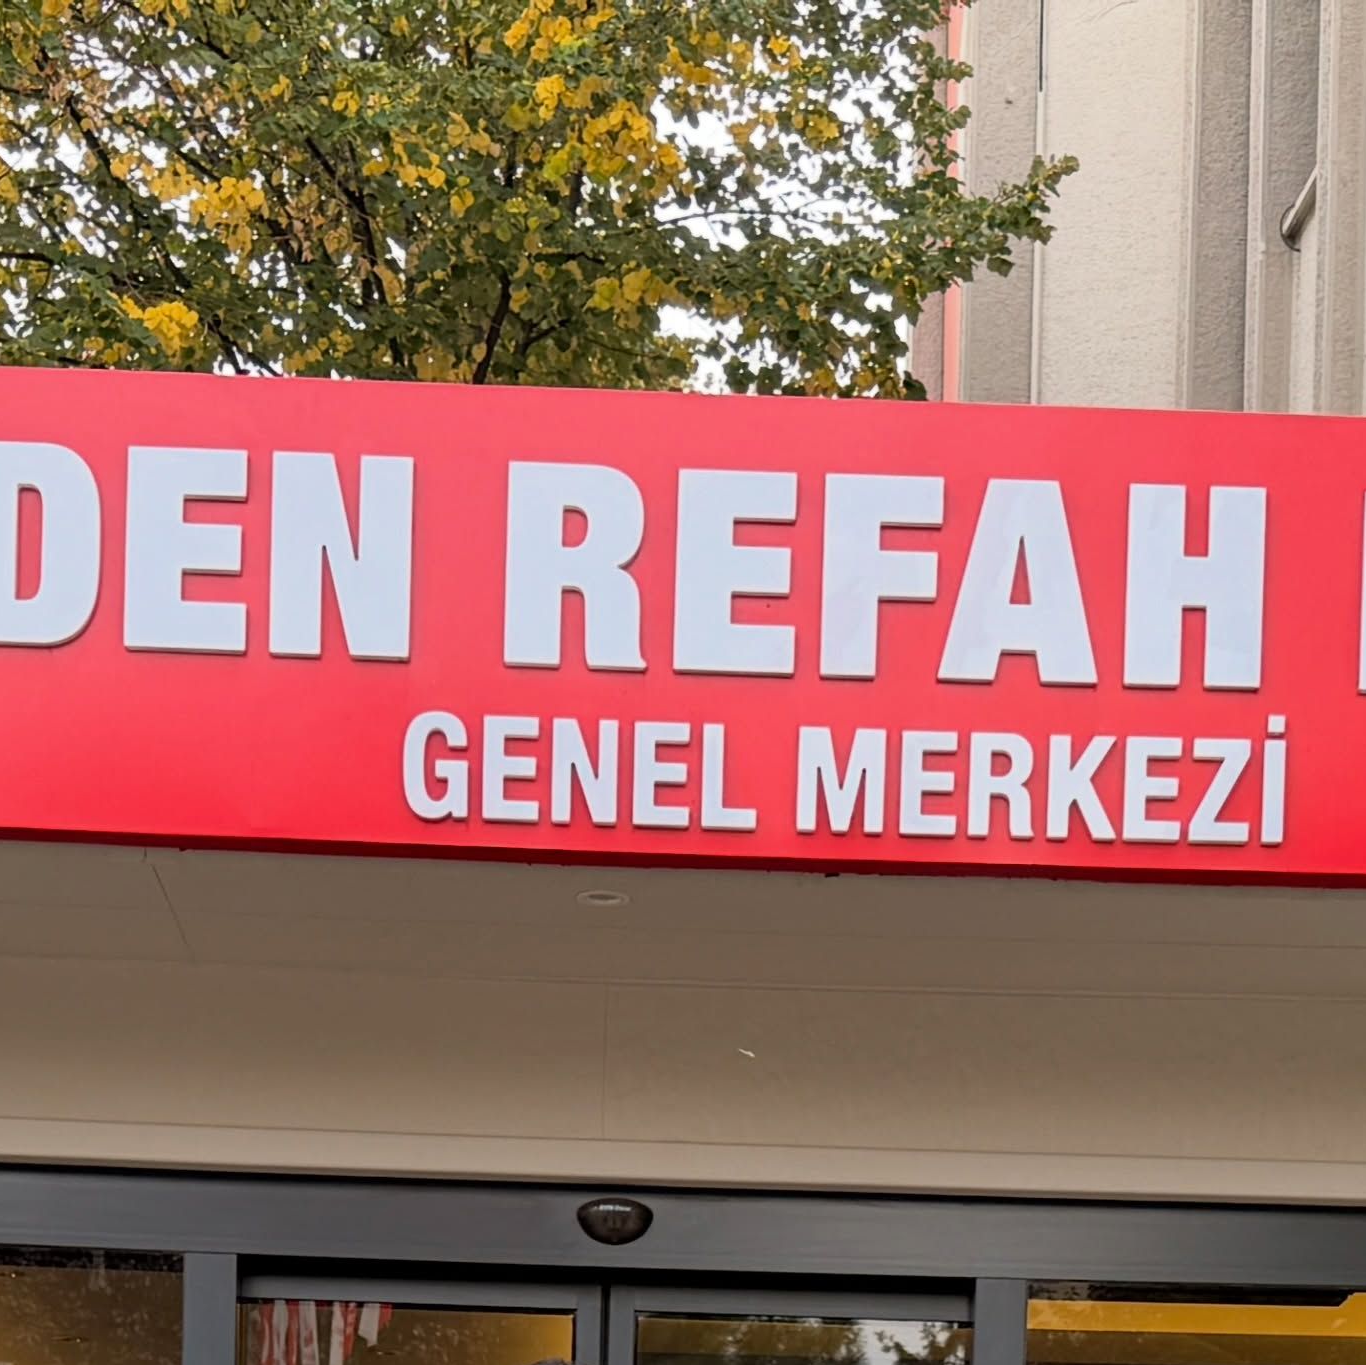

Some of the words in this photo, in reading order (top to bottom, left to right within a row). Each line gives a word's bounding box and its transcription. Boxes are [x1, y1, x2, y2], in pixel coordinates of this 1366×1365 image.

[502, 461, 1268, 692] REFAH
[403, 711, 758, 832] GENEL
[796, 715, 1287, 846] MERKEZİ
